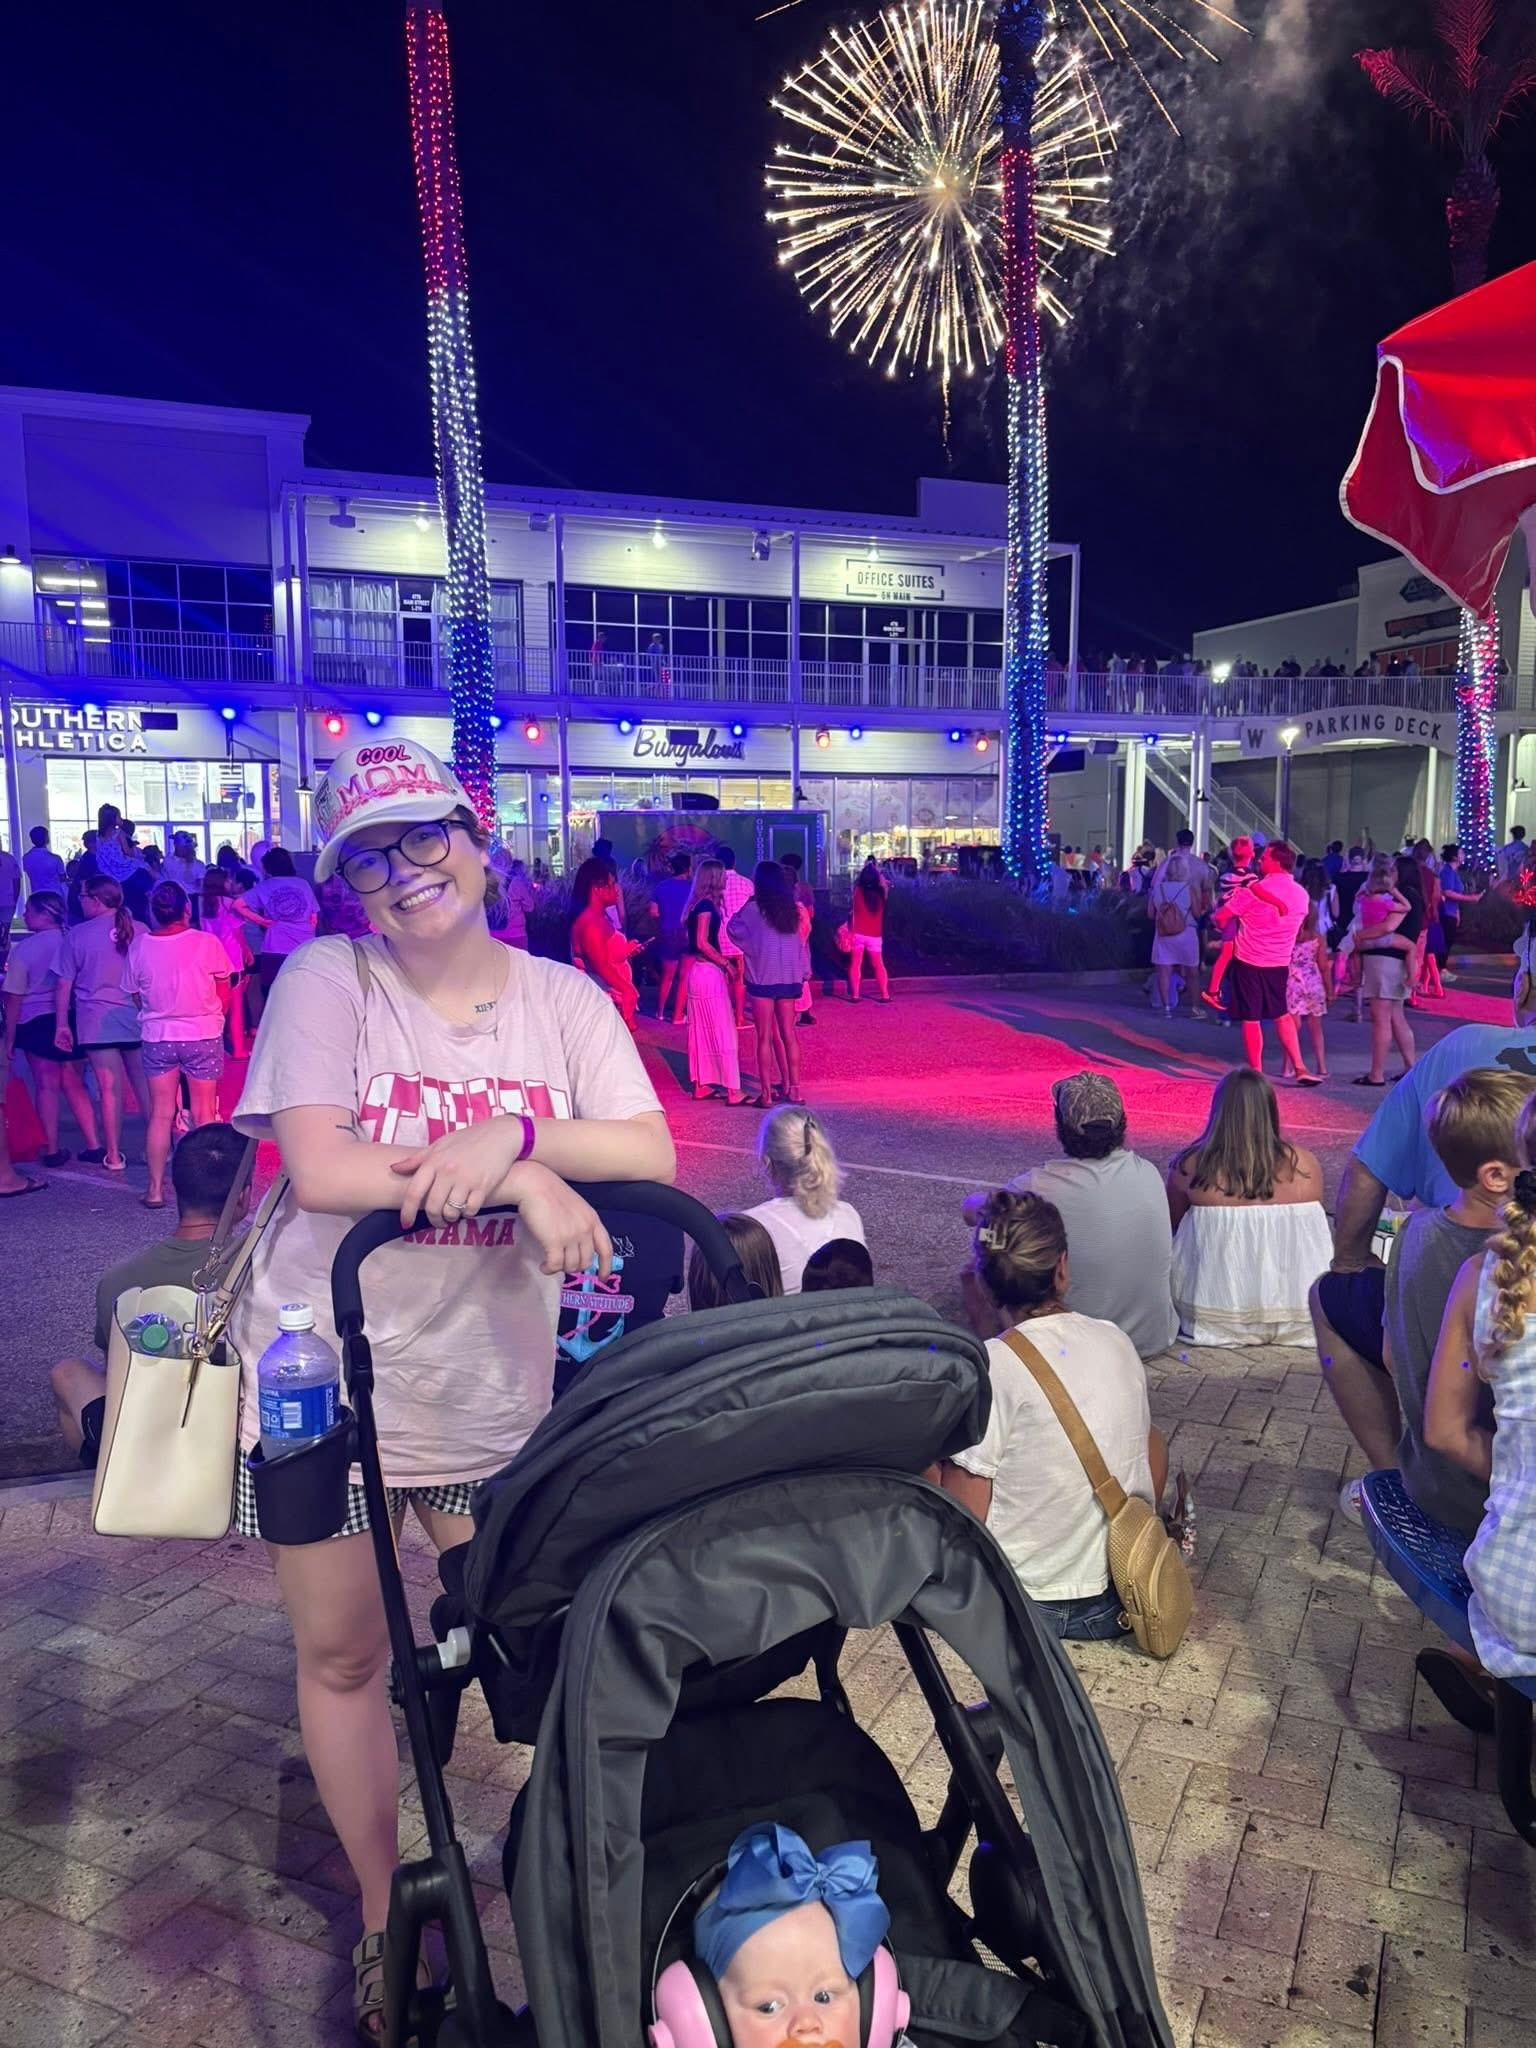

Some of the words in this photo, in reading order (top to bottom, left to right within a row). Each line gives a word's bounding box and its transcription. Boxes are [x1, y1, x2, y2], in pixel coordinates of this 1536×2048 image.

[858, 572, 894, 586] OFFICE
[897, 574, 935, 589] SUITES
[881, 591, 891, 600] ON
[893, 592, 911, 601] MAIN
[1305, 714, 1386, 739] PARKING
[1394, 716, 1442, 741] DECK
[0, 729, 148, 751] HLETICA
[356, 744, 412, 767] COOL
[336, 763, 435, 806] MOM
